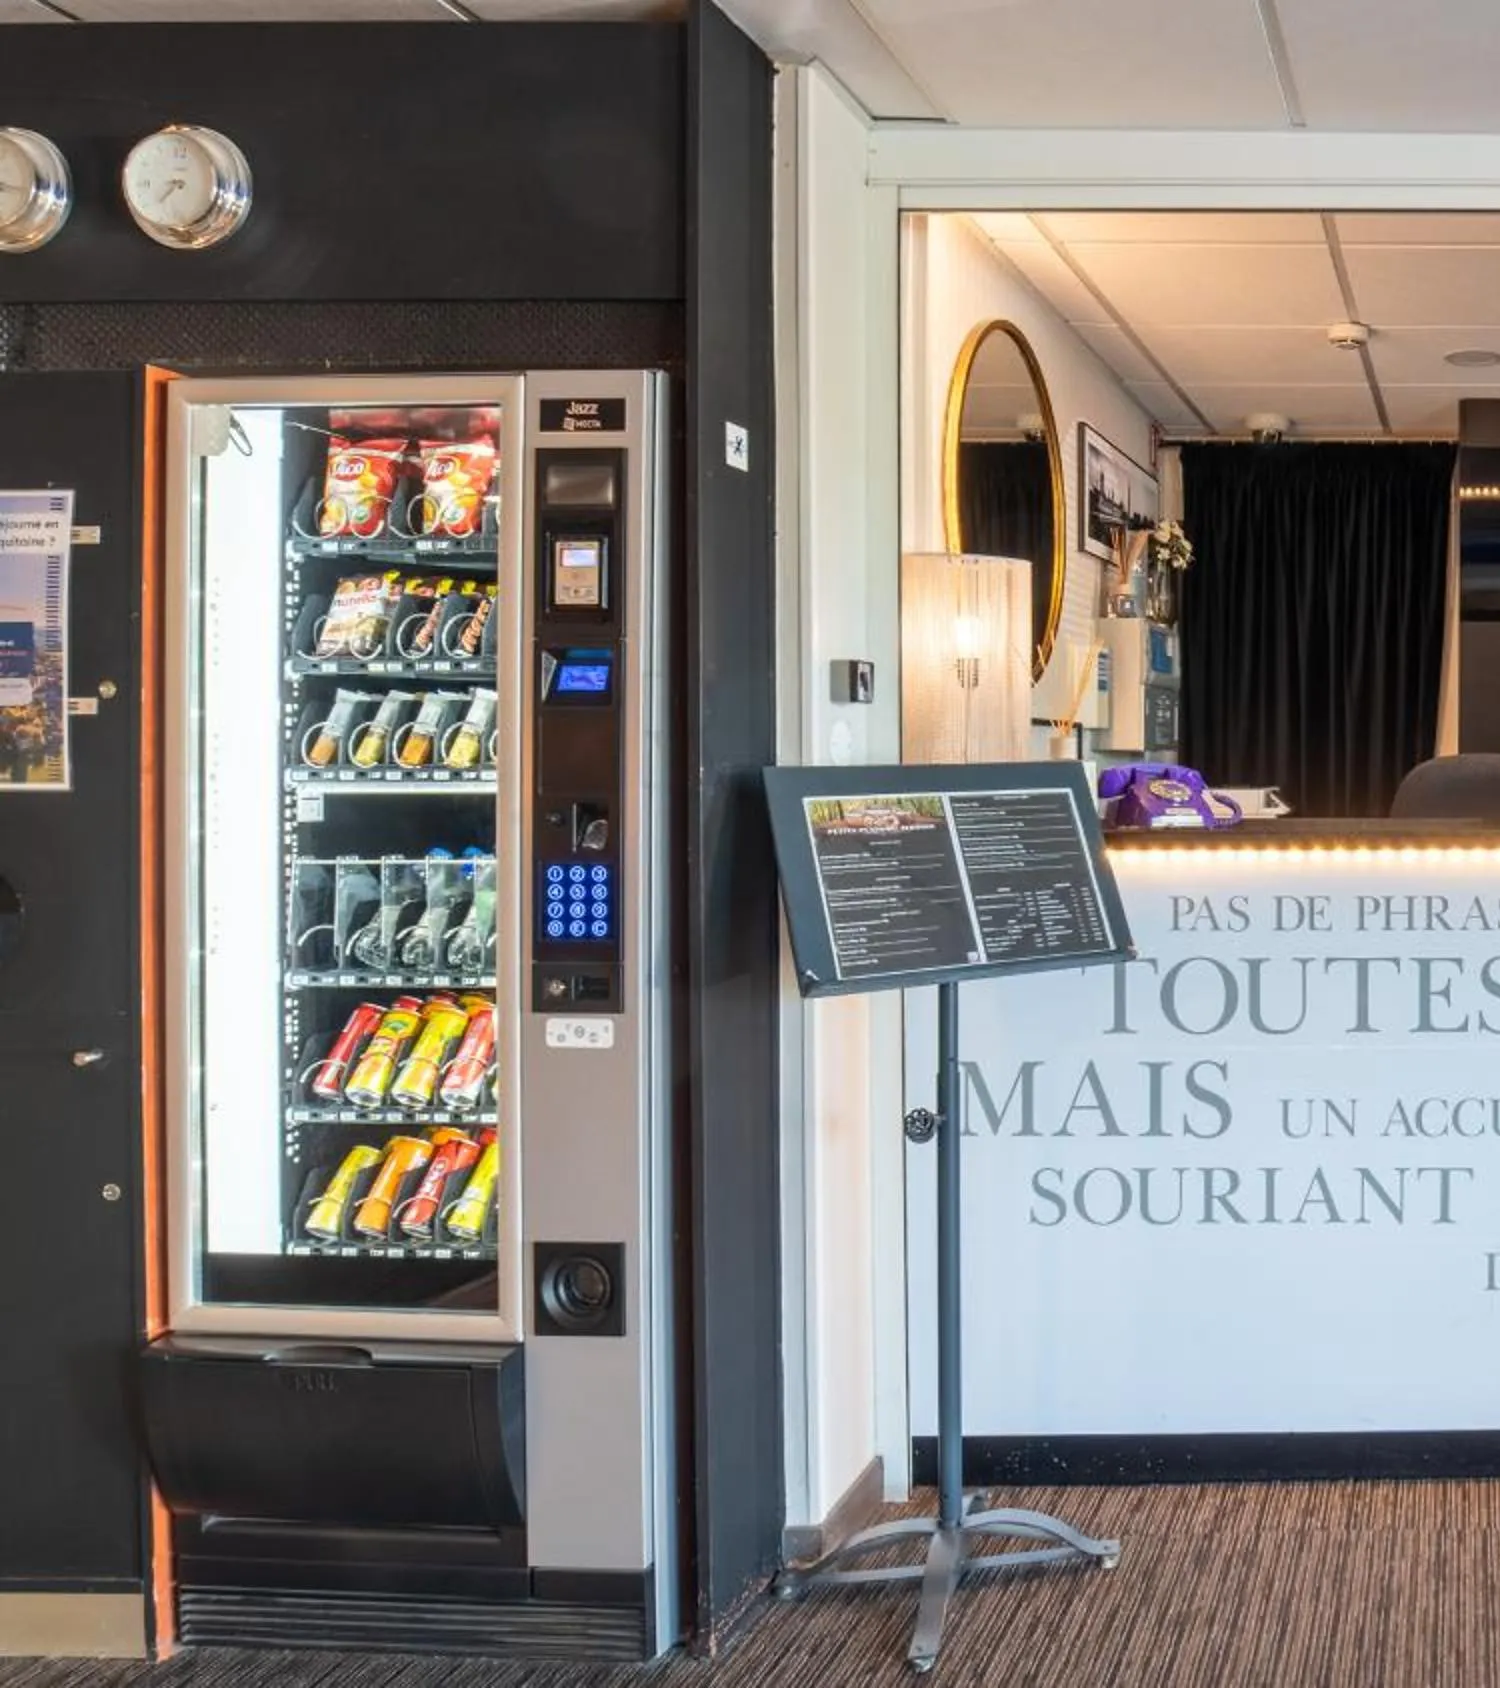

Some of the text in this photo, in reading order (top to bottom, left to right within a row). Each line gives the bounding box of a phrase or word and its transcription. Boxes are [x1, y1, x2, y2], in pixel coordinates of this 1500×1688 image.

[566, 401, 599, 415] Jazz
[1171, 895, 1251, 933] PAS
[1273, 896, 1333, 932] DE
[959, 1058, 1233, 1139] MAIS
[1281, 1098, 1357, 1138] UN
[1029, 1167, 1475, 1227] SOURIANT
